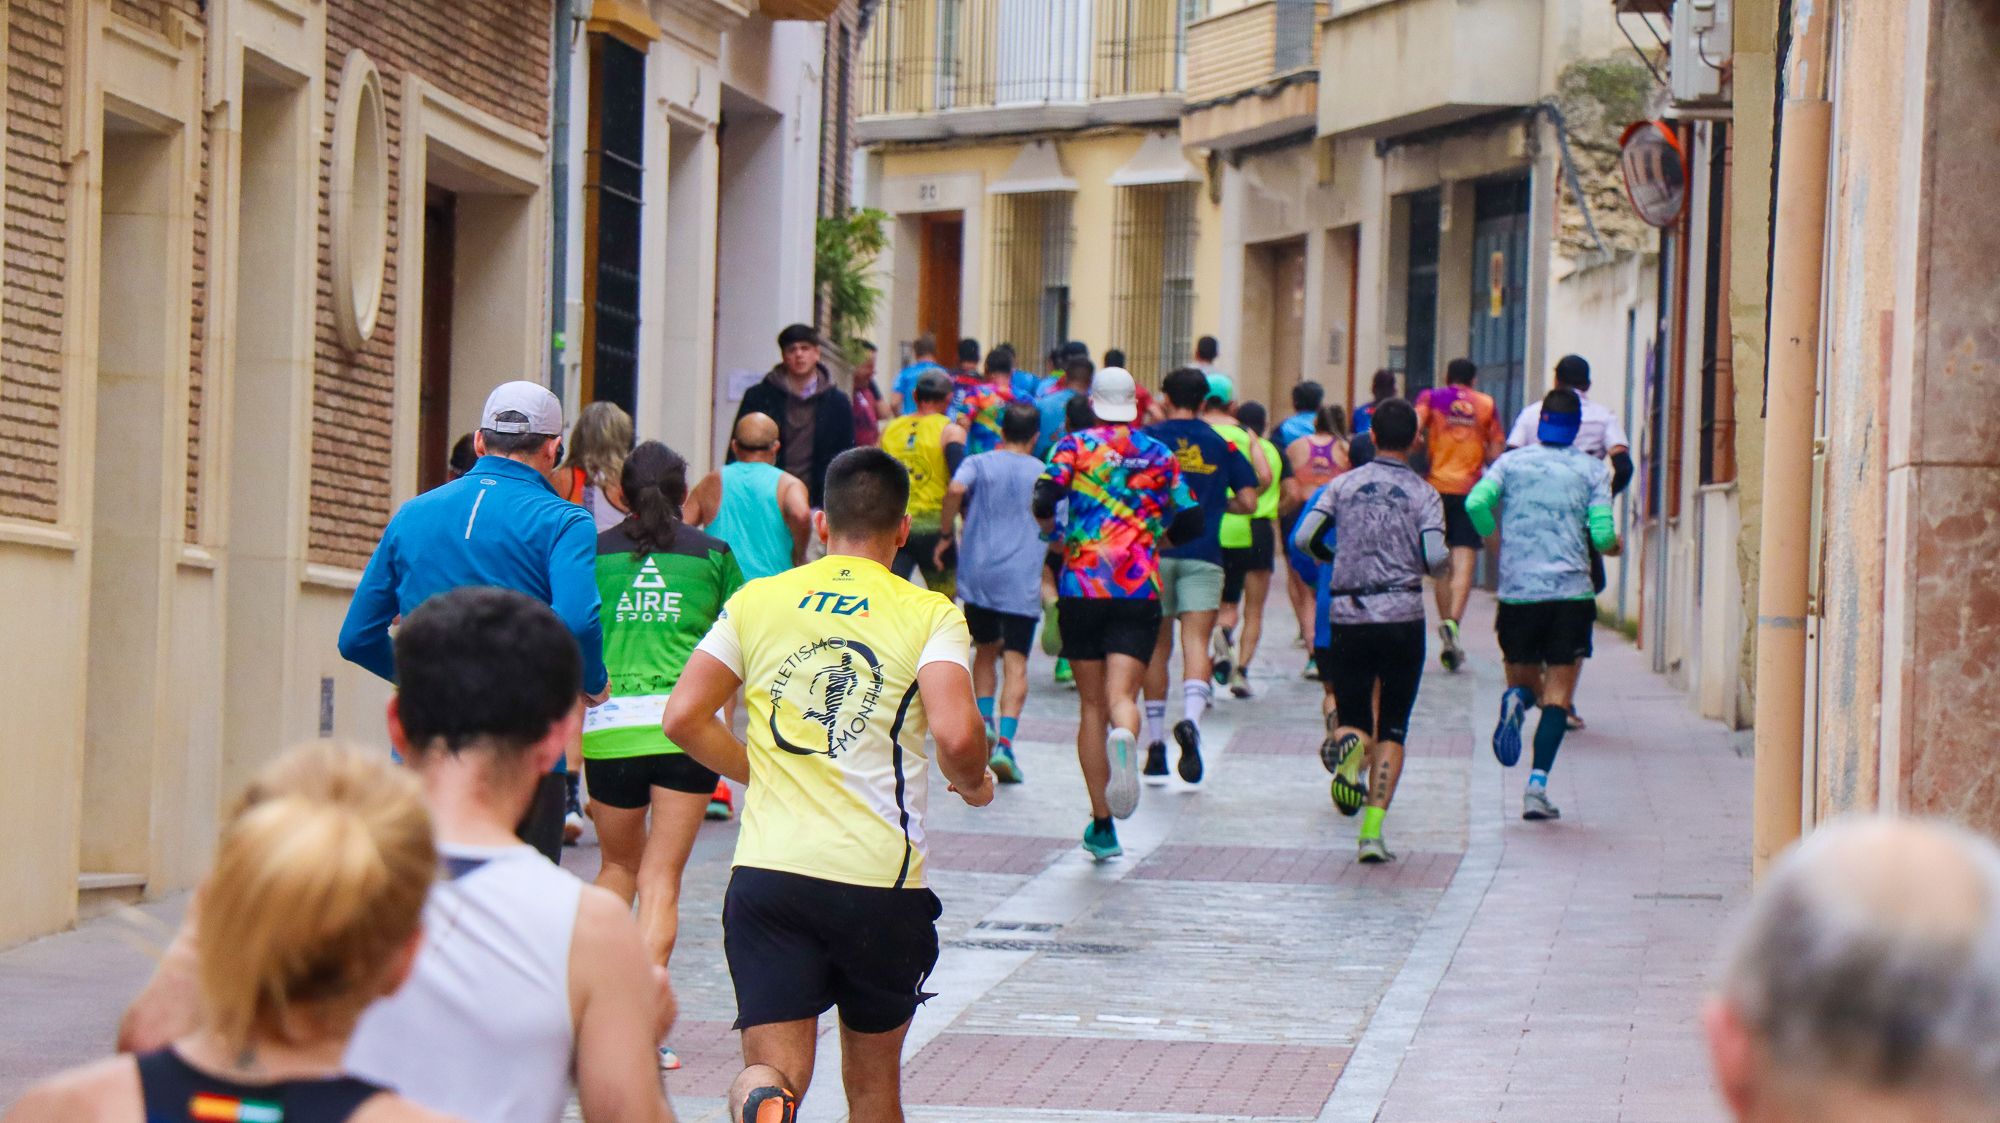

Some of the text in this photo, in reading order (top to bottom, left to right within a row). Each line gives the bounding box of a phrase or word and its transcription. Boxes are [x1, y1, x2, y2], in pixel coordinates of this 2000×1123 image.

[616, 591, 683, 613] AIRE
[616, 612, 681, 623] SPORT
[770, 636, 847, 709] ATLETISMO
[835, 663, 884, 752] MONTILLA
